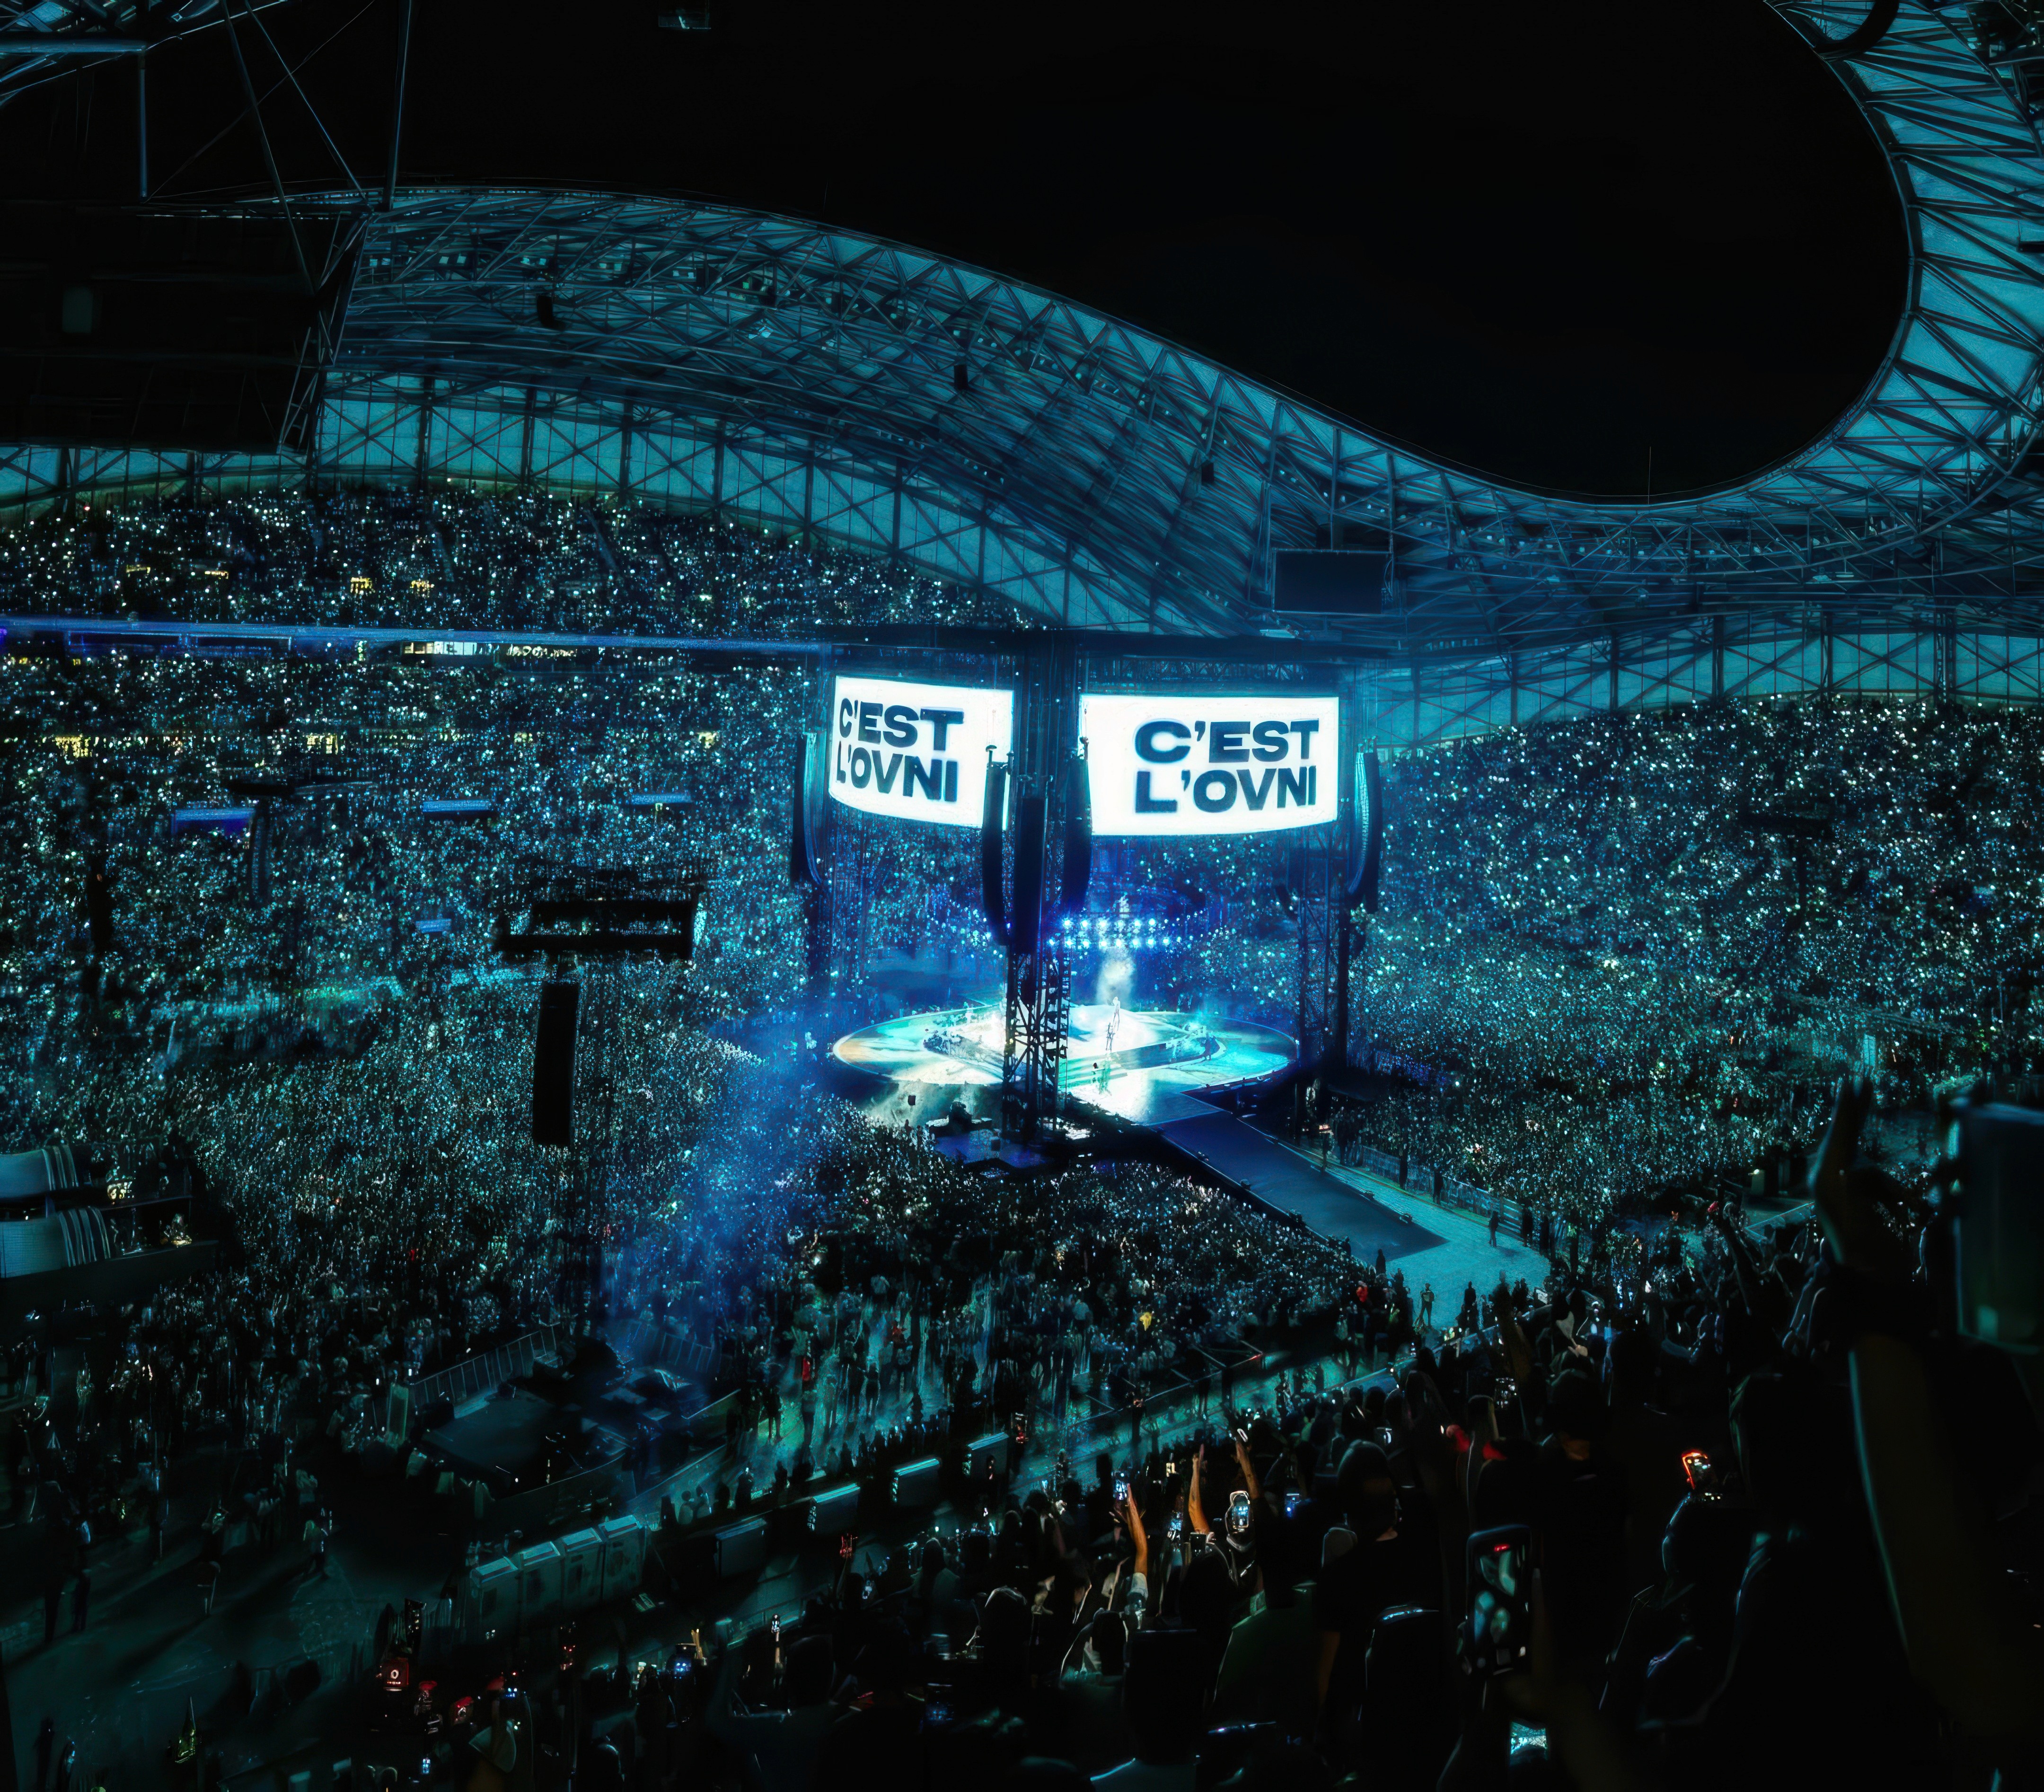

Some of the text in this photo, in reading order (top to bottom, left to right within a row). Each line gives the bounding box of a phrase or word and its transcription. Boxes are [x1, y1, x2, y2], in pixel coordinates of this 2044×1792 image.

[839, 698, 964, 752] C'EST
[1134, 718, 1319, 764] C'EST
[837, 741, 959, 803] L'OVNI
[1134, 765, 1316, 814] L'OVNI
